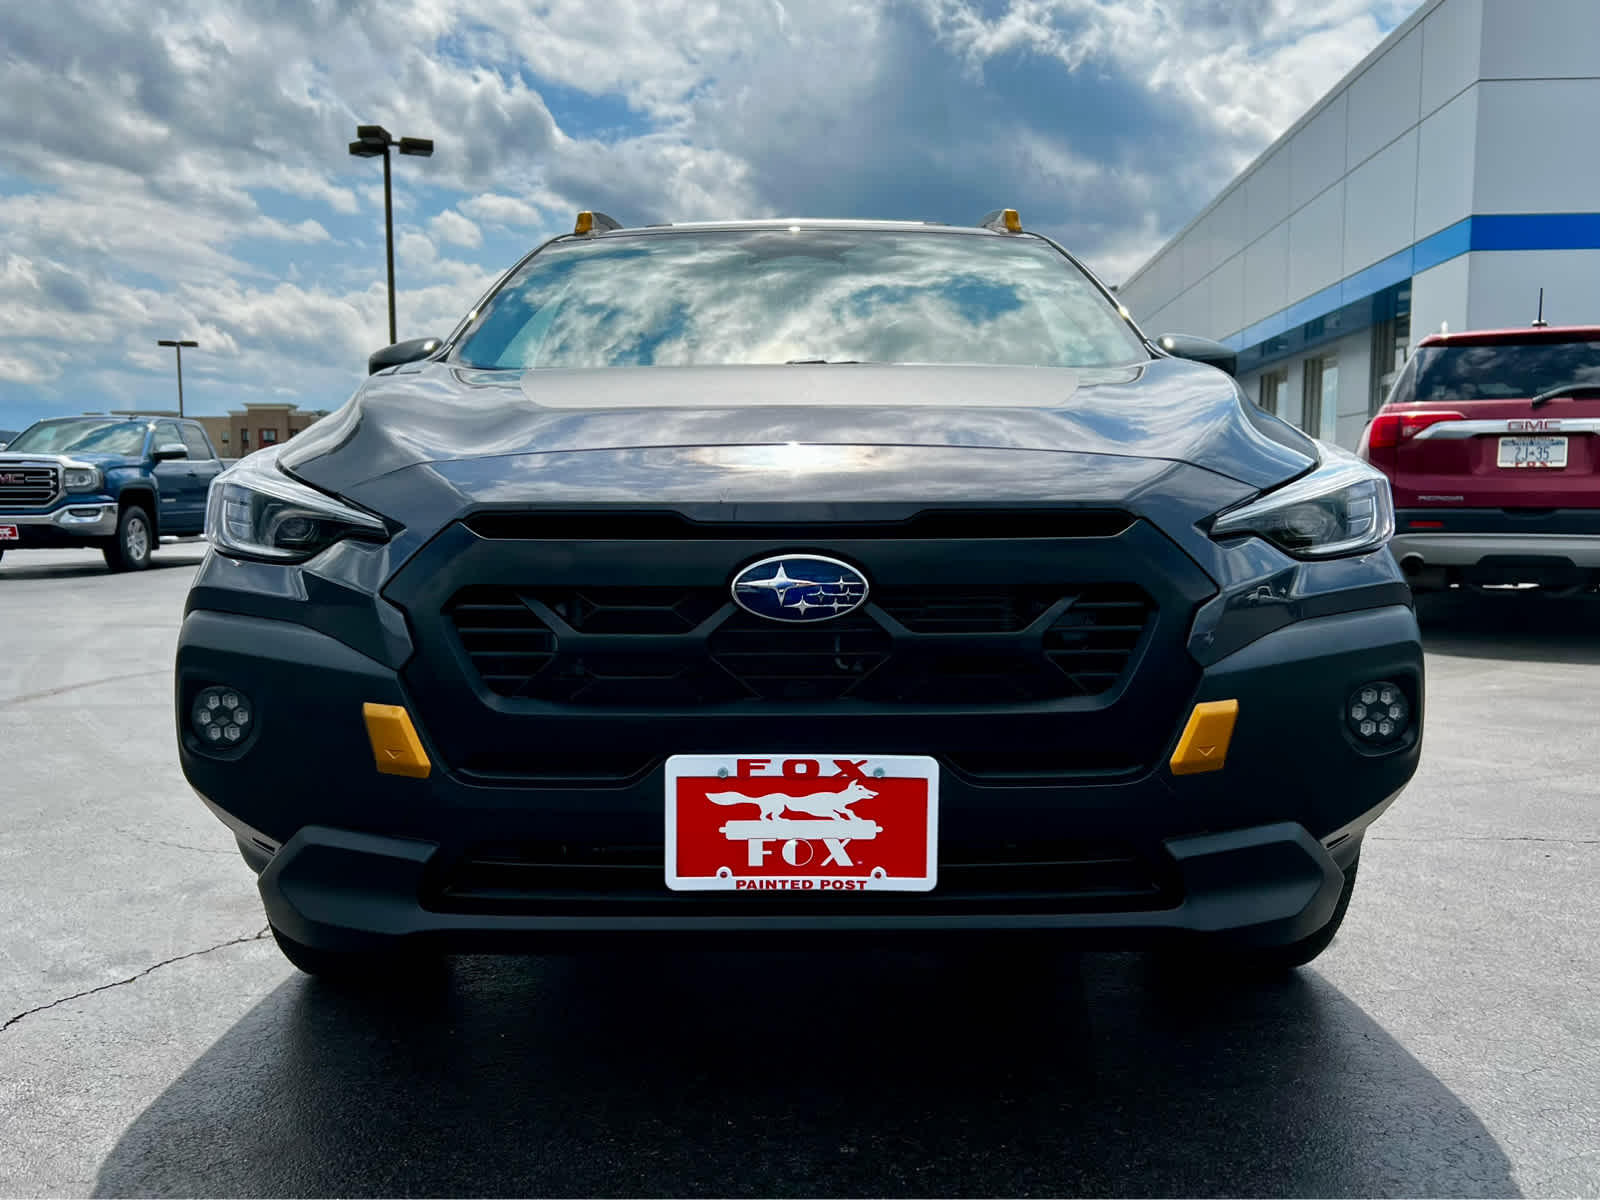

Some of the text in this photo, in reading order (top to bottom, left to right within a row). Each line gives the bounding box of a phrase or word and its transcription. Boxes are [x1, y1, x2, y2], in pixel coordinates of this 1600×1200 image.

[1508, 420, 1561, 431] GMC
[0, 473, 25, 484] MC
[737, 759, 868, 778] FOX
[748, 838, 854, 867] FOX
[735, 879, 868, 890] PAINTED POST
